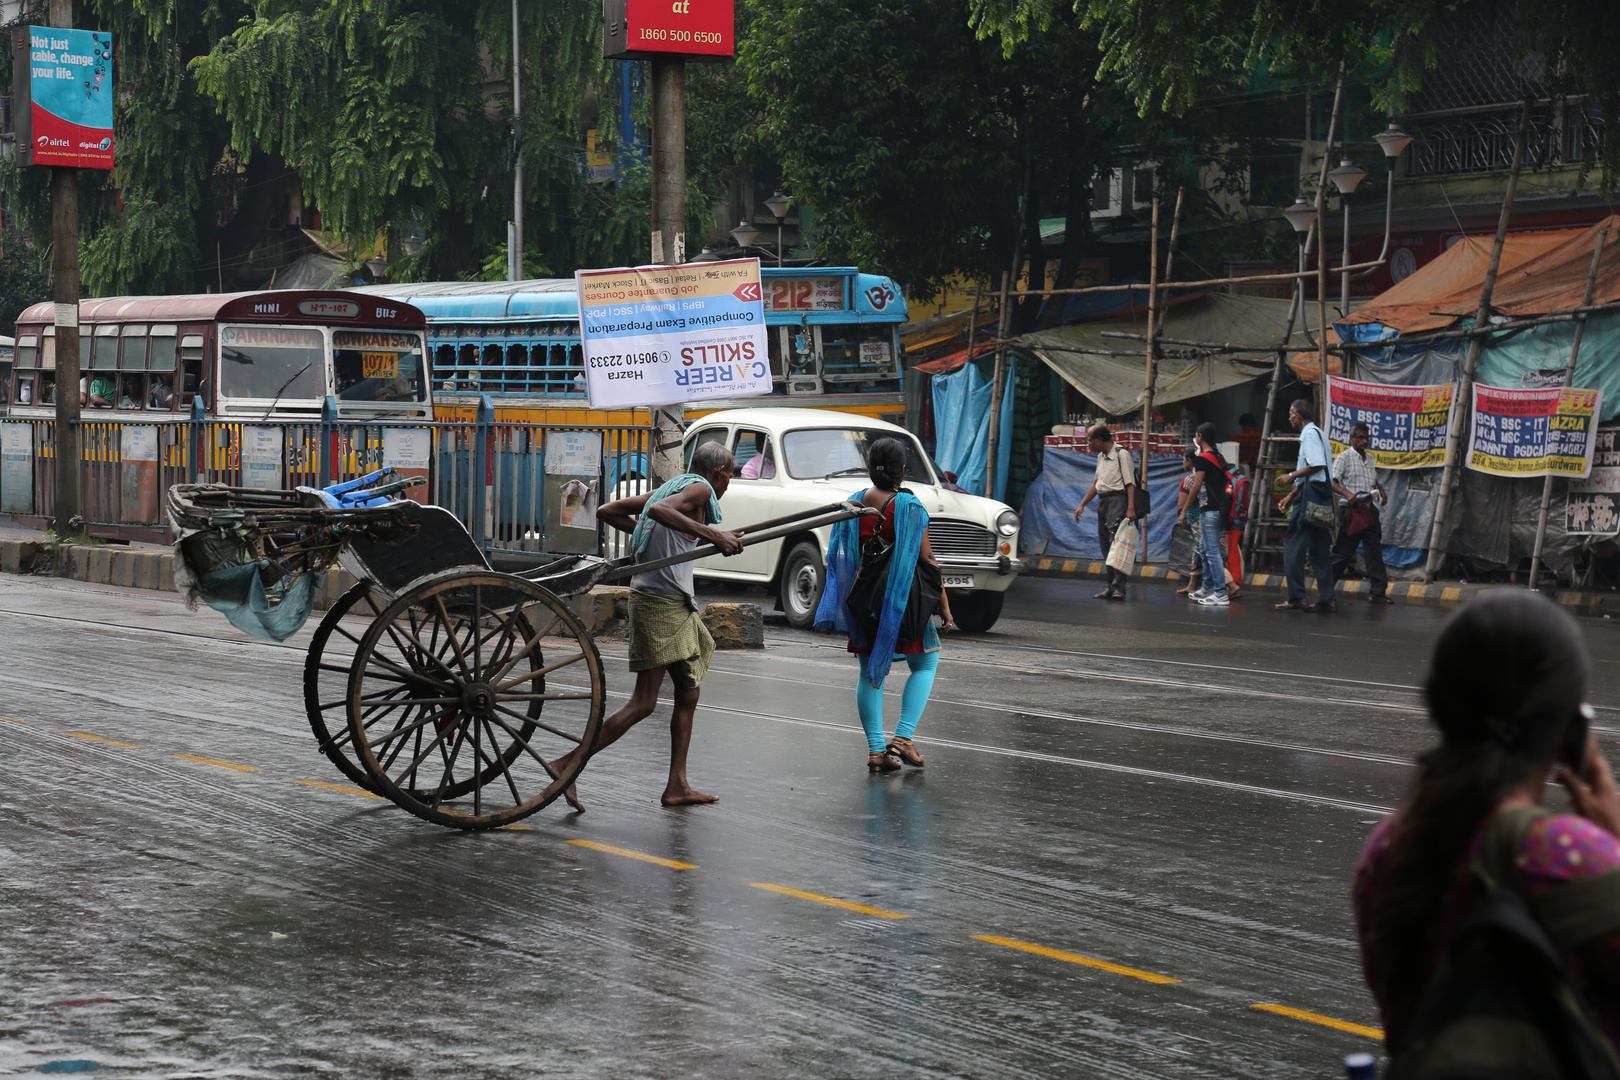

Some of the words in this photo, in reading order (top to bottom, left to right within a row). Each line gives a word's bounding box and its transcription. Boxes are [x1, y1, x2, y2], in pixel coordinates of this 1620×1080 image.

[672, 0, 690, 14] at
[640, 28, 666, 40] 1860
[670, 30, 691, 42] 500
[694, 31, 722, 44] 6500
[32, 36, 48, 48] Not
[51, 39, 69, 50] just
[32, 51, 59, 64] cable,
[60, 53, 94, 66] change
[32, 67, 53, 79] your
[56, 67, 74, 80] life.
[50, 138, 70, 147] airtel
[675, 274, 697, 283] Retail
[721, 271, 736, 279] with
[737, 269, 748, 277] FA
[584, 281, 610, 290] Market
[612, 280, 633, 288] Stock
[648, 276, 669, 285] Basic
[628, 287, 678, 298] Guarantee
[681, 284, 699, 294] Job
[585, 291, 626, 302] Courses
[772, 280, 814, 311] 212
[254, 303, 280, 313] MINI
[310, 304, 349, 313] HT-107
[613, 307, 633, 315] SSC
[640, 303, 675, 313] Railway
[682, 301, 704, 311] IBPS
[376, 307, 397, 319] BUS
[689, 311, 754, 326] Competitive
[588, 321, 652, 334] Preparation
[655, 318, 686, 329] Exam
[626, 352, 658, 365] 90510
[680, 341, 755, 366] SKILLS
[363, 354, 395, 369] 107/1
[590, 355, 622, 368] 22333
[607, 370, 643, 380] Hazra
[674, 362, 766, 386] CAREER
[713, 384, 735, 392] Alumni
[1423, 386, 1454, 404] PTU
[1559, 391, 1598, 408] PTU
[1357, 410, 1380, 423] BSC
[1395, 414, 1408, 426] IT
[1476, 414, 1497, 429] BCA
[1501, 418, 1522, 431] BSC
[1534, 418, 1545, 430] IT
[1394, 427, 1406, 438] IT
[1477, 427, 1496, 442] MCA
[1501, 431, 1521, 444] MSC
[1533, 431, 1543, 444] IT
[1371, 438, 1408, 451] PGDCA
[1514, 444, 1544, 457] PGDCA
